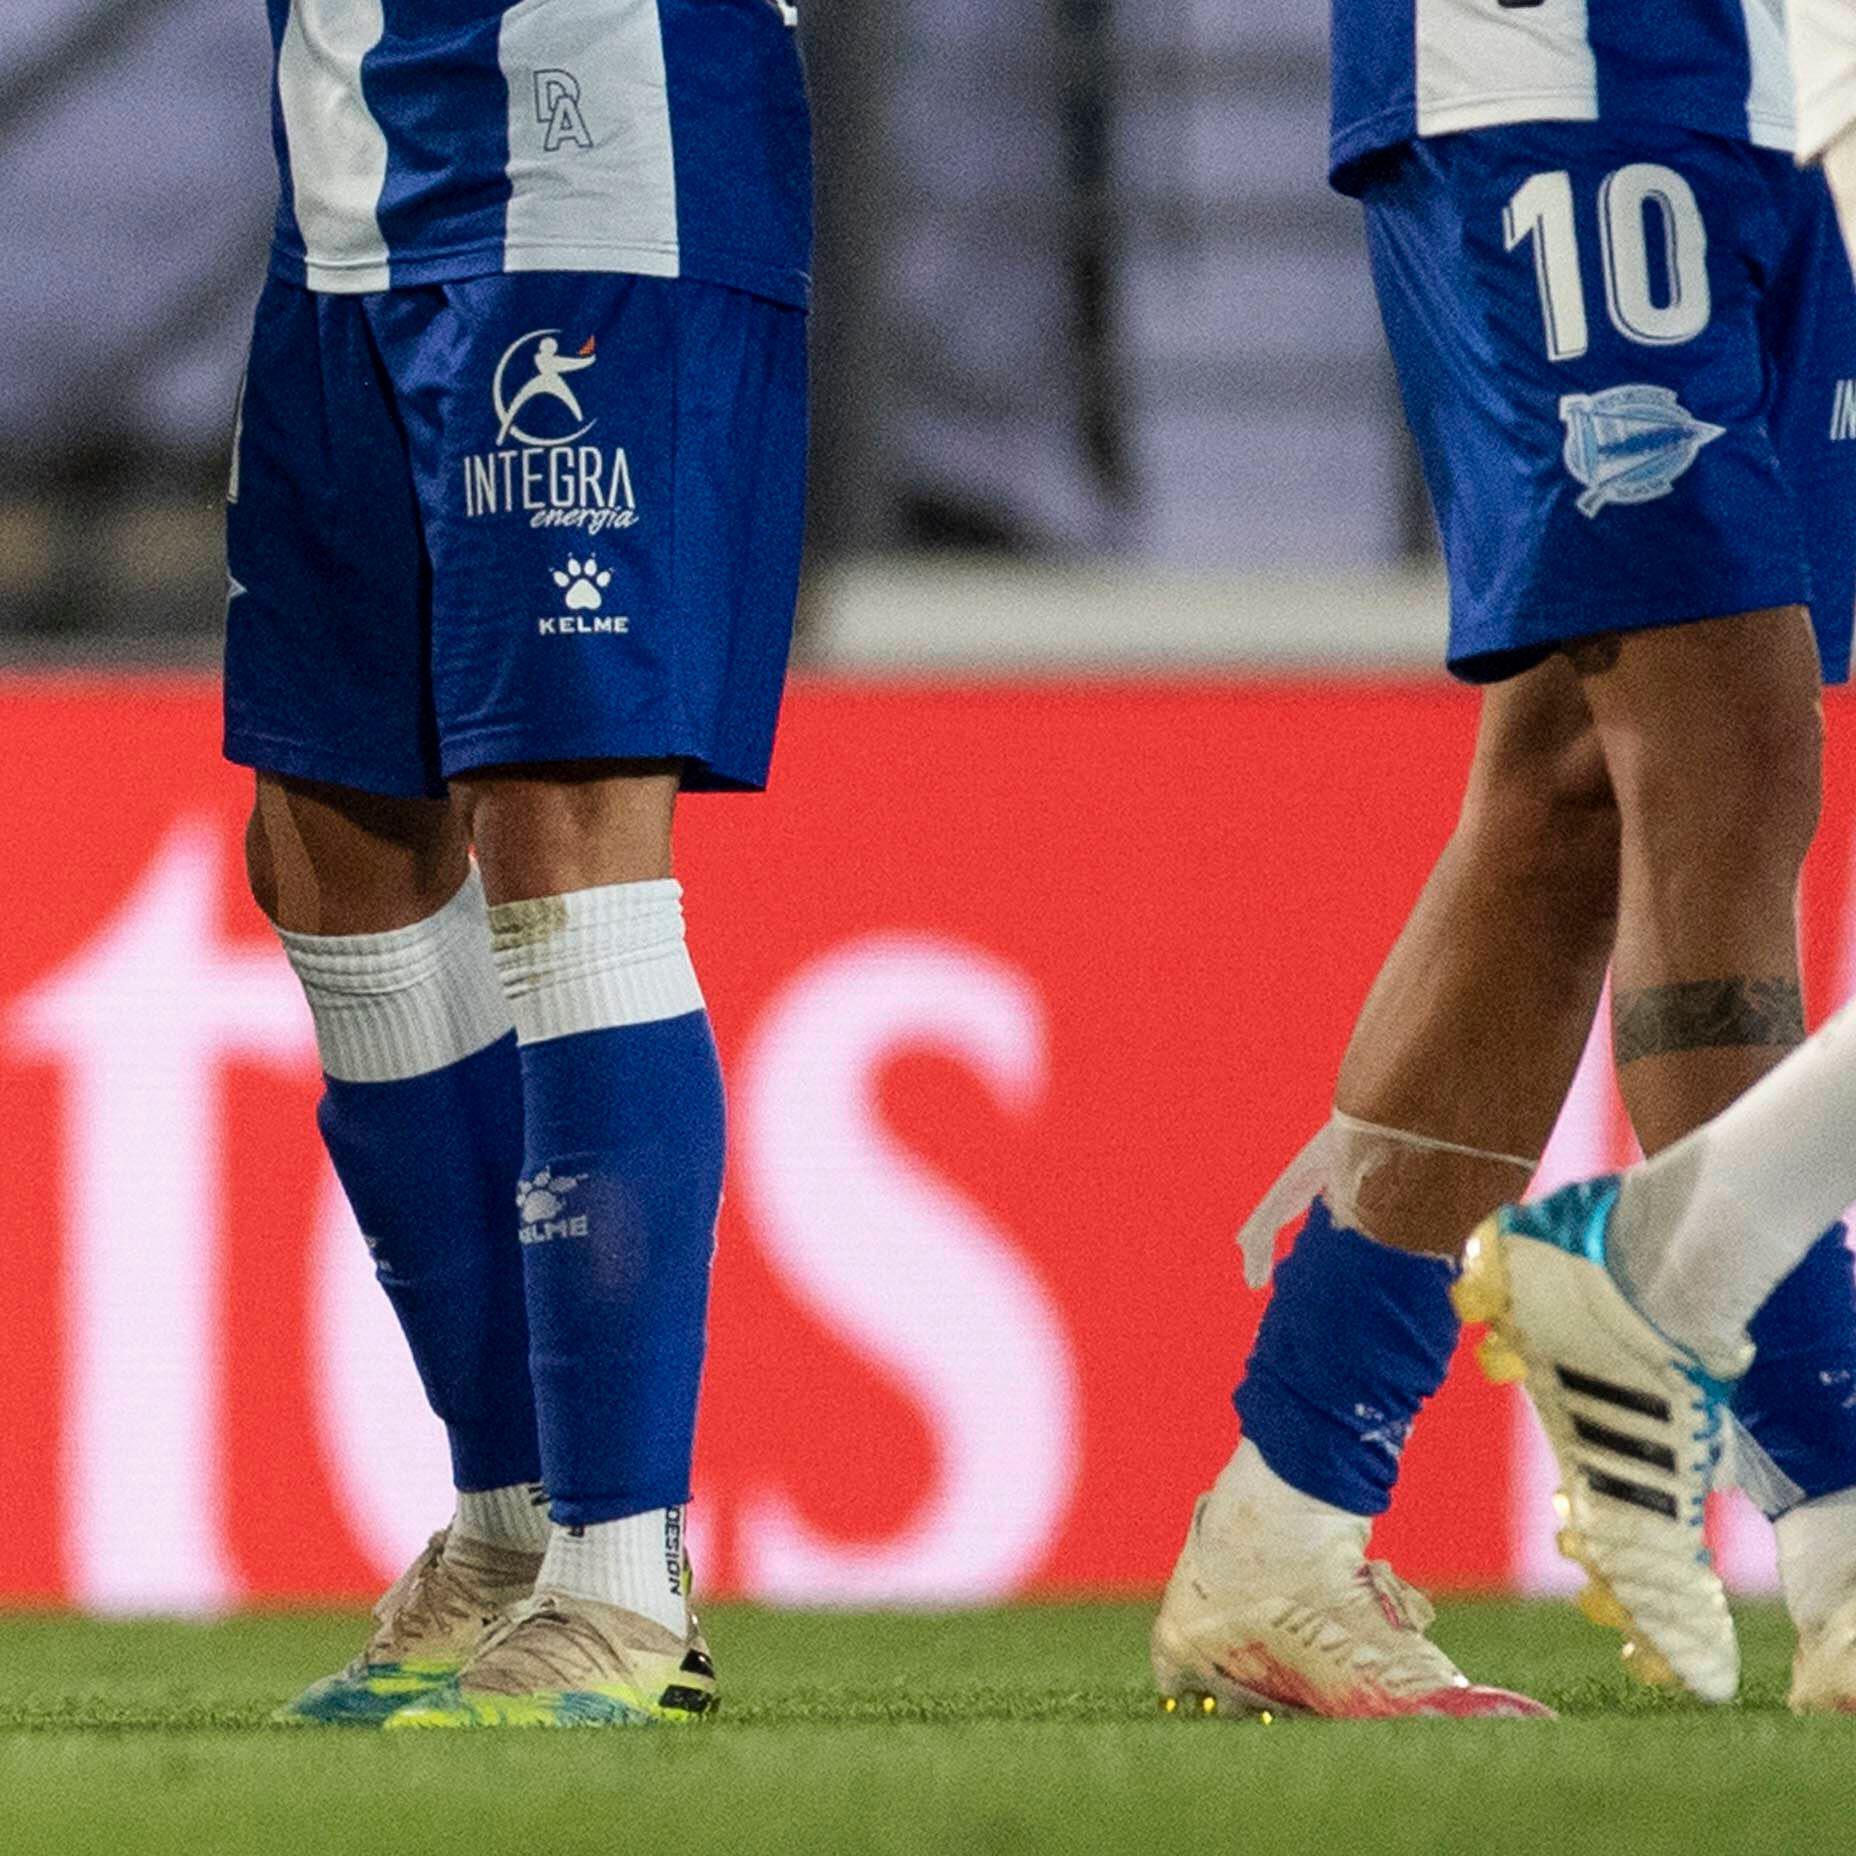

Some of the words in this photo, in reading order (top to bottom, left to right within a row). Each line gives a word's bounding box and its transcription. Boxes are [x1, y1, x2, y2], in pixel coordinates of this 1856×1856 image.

[1502, 162, 1712, 362] 10
[463, 446, 637, 518] INTEGRA
[539, 616, 630, 635] KELME
